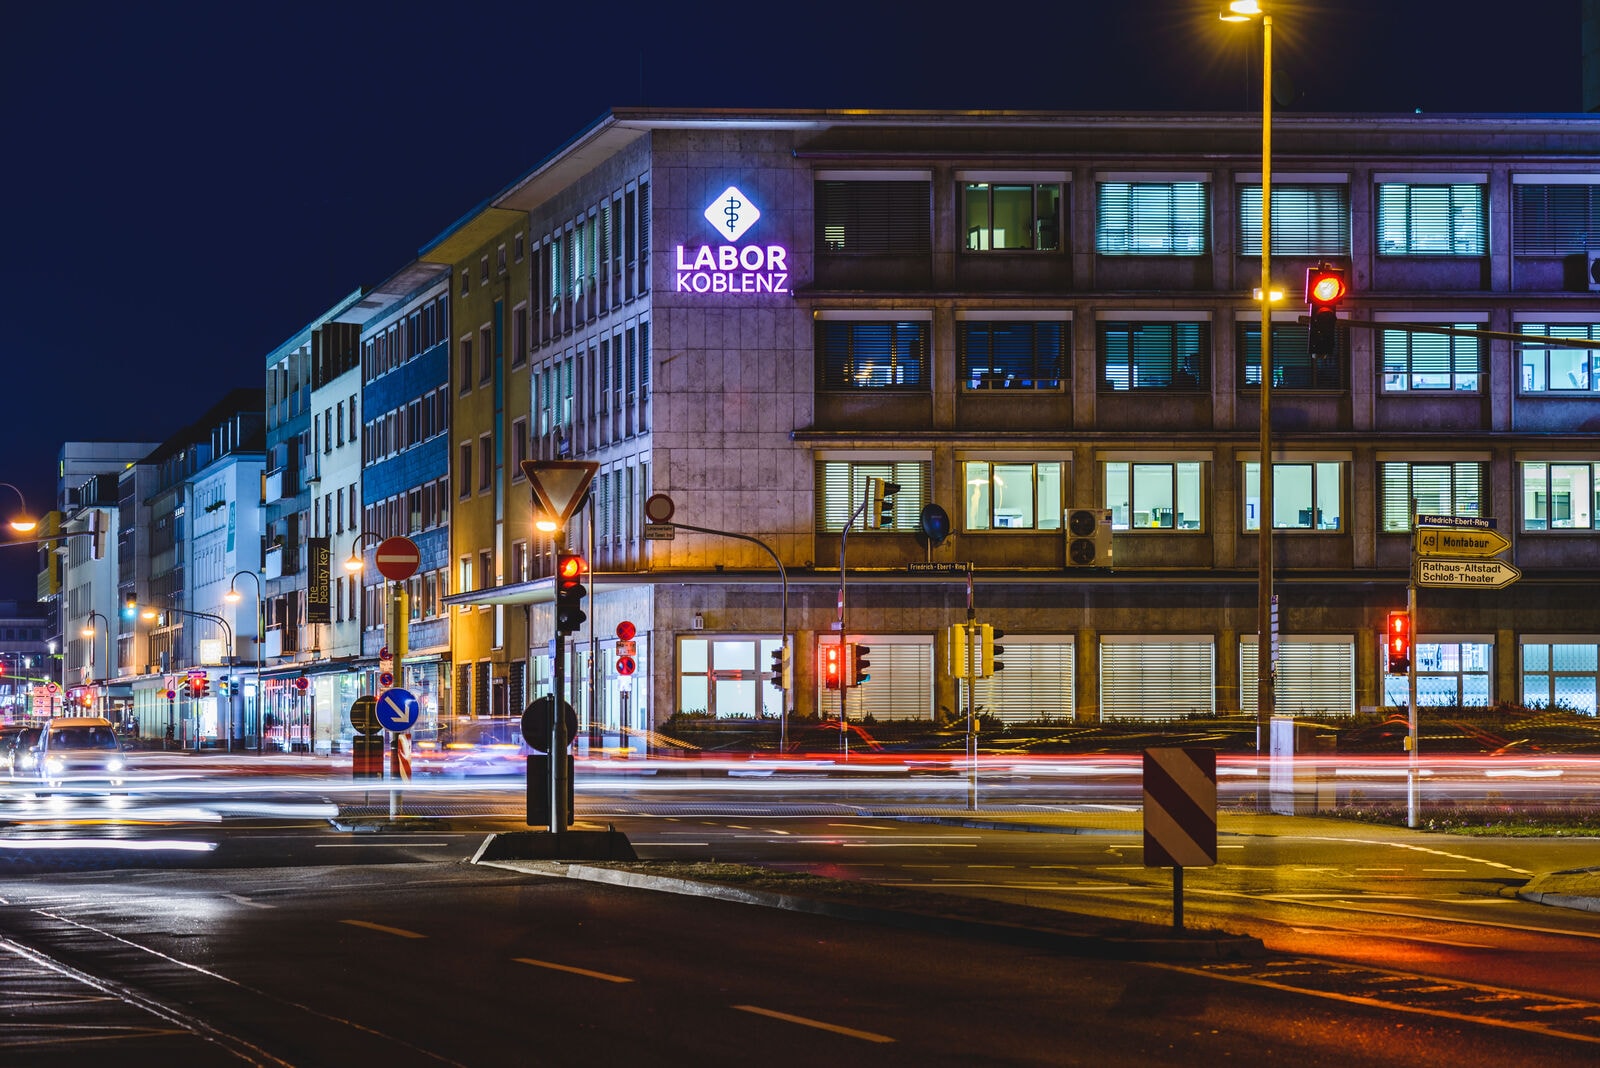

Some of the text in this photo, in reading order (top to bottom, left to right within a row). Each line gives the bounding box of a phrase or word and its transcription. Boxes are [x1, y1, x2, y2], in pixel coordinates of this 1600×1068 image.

[676, 245, 788, 271] LABOR
[676, 272, 788, 293] KOBLENZ
[1424, 516, 1489, 528] Friedrich-Ebert-Ring
[1422, 536, 1490, 548] 49 Montabaur
[1422, 562, 1501, 574] Rathaus-Altstadt
[318, 547, 330, 604] beauty key
[1422, 572, 1495, 583] Schloß-Theater
[308, 586, 318, 603] the
